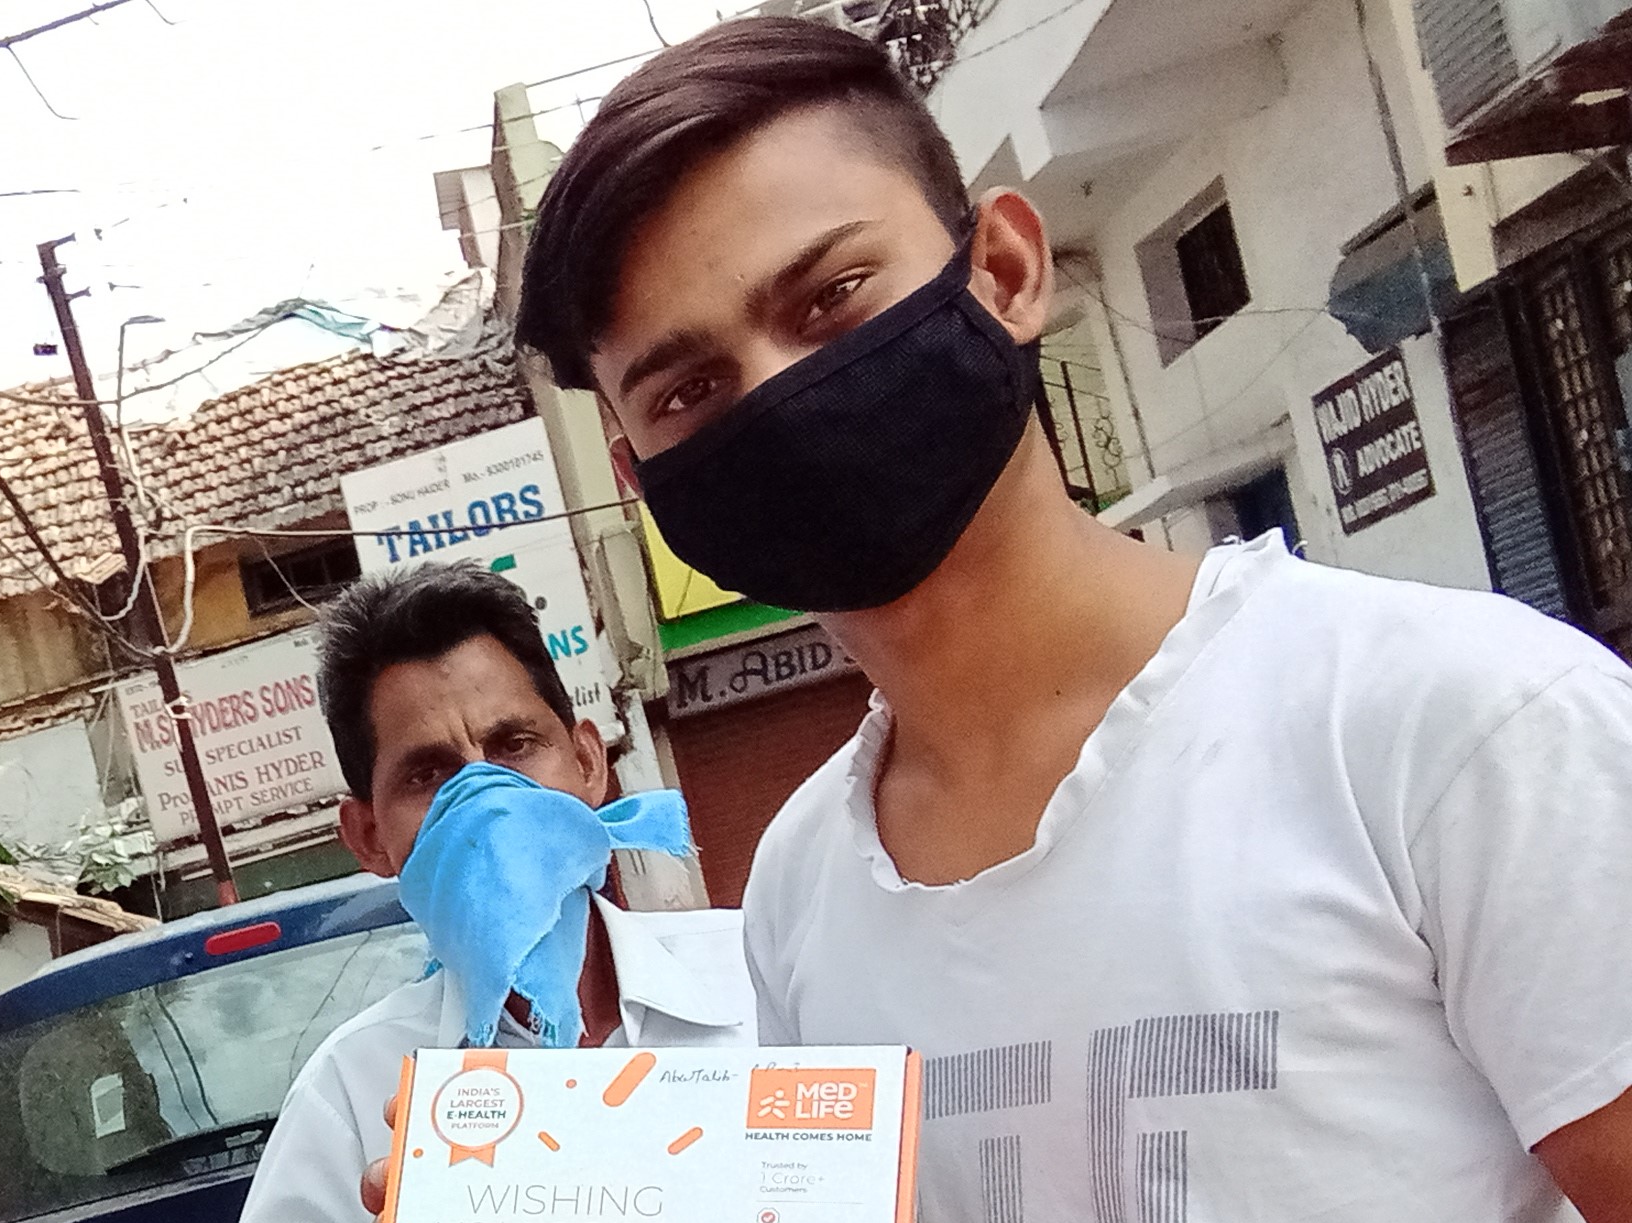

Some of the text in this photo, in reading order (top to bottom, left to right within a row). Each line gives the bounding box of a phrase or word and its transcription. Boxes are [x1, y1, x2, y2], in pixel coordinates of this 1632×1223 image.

[1357, 421, 1422, 477] ADVOCATE
[376, 484, 545, 563] TAILORS
[547, 625, 590, 661] NS
[259, 674, 316, 719] SONS
[205, 725, 303, 765] SPECIALIST
[255, 750, 327, 784] HYDER
[251, 777, 314, 807] SERVICE
[450, 1099, 505, 1108] LARGEST
[458, 1088, 500, 1097] INDIA'S
[447, 1110, 506, 1119] E-HEALTH
[745, 1132, 873, 1142] HEALTH COMES HOME
[761, 1161, 808, 1171] Trusted by
[468, 1185, 663, 1216] WISHING
